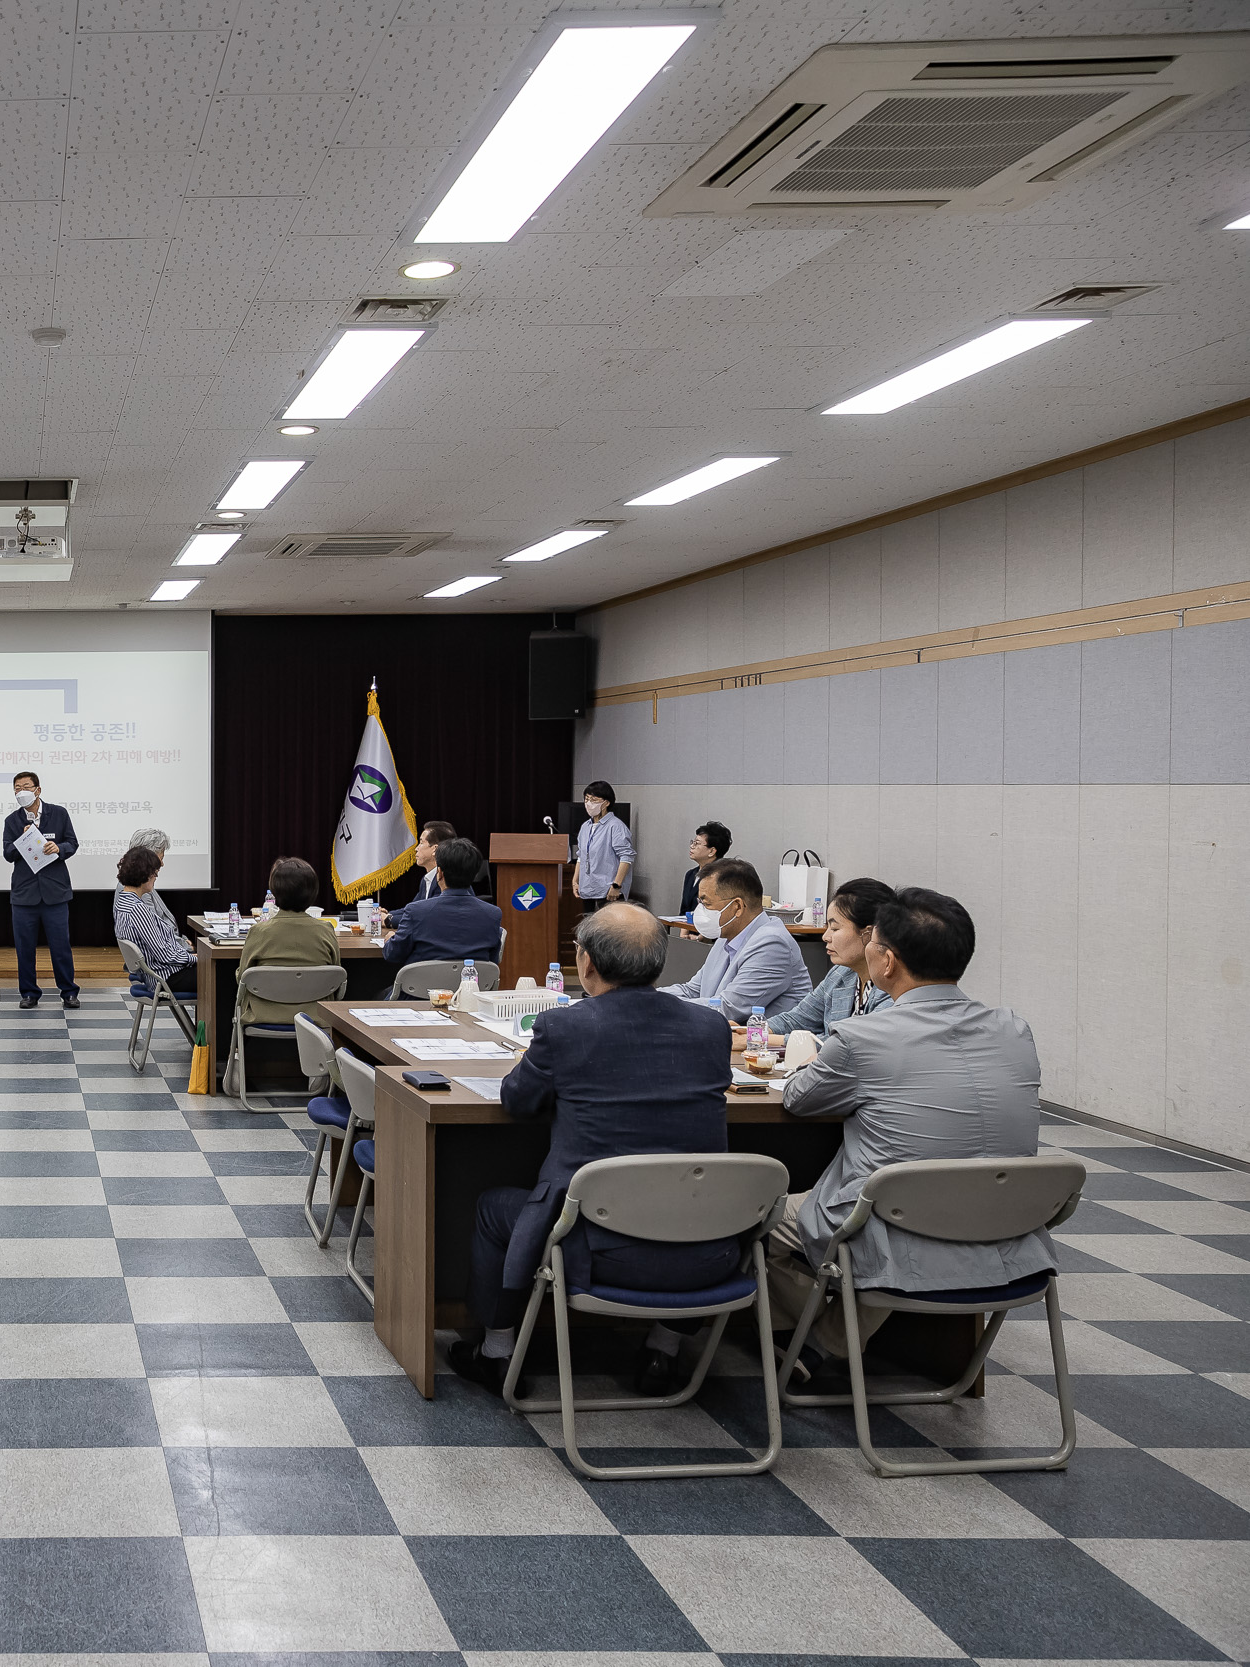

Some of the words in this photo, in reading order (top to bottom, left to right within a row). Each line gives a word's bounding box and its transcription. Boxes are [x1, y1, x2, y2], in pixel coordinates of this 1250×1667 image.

[33, 723, 85, 742] 평등한
[90, 722, 136, 742] 공존!!
[49, 751, 88, 764] 권리와
[91, 750, 112, 764] 2차
[116, 749, 143, 764] 피해
[145, 748, 182, 763] 예방!!
[95, 800, 153, 814] 맞춤형교육
